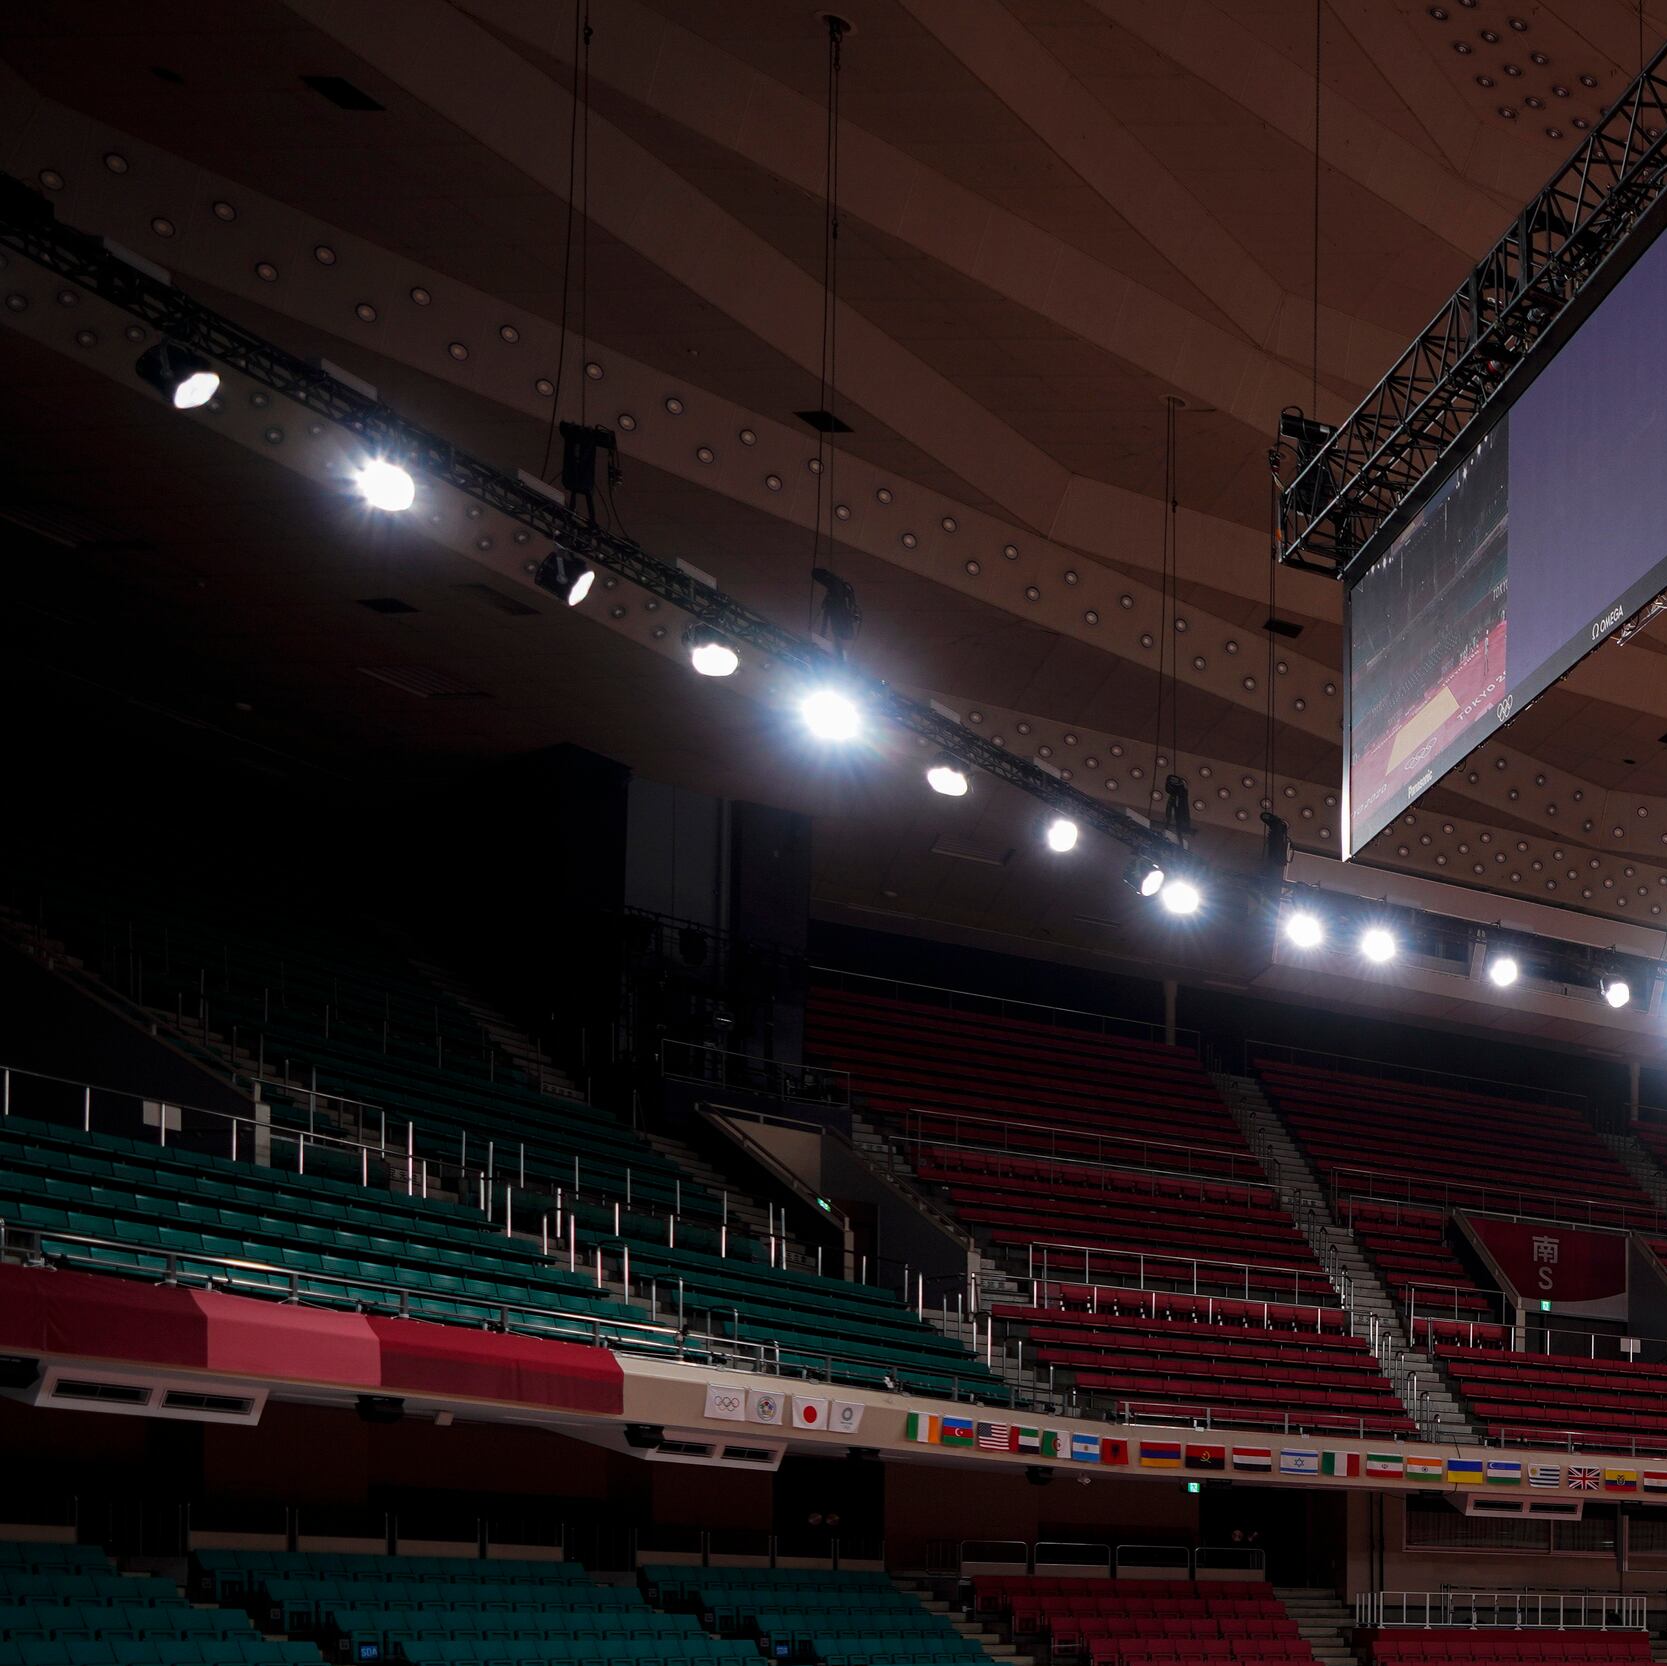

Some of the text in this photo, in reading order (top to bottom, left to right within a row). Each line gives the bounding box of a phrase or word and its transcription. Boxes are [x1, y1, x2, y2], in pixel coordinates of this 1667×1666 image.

[1600, 605, 1624, 632] OMEGA
[1456, 682, 1496, 721] TOKYO
[1408, 769, 1433, 799] Panasonic
[1532, 1235, 1560, 1264] 南
[1538, 1266, 1553, 1290] S
[360, 1646, 378, 1658] SDA
